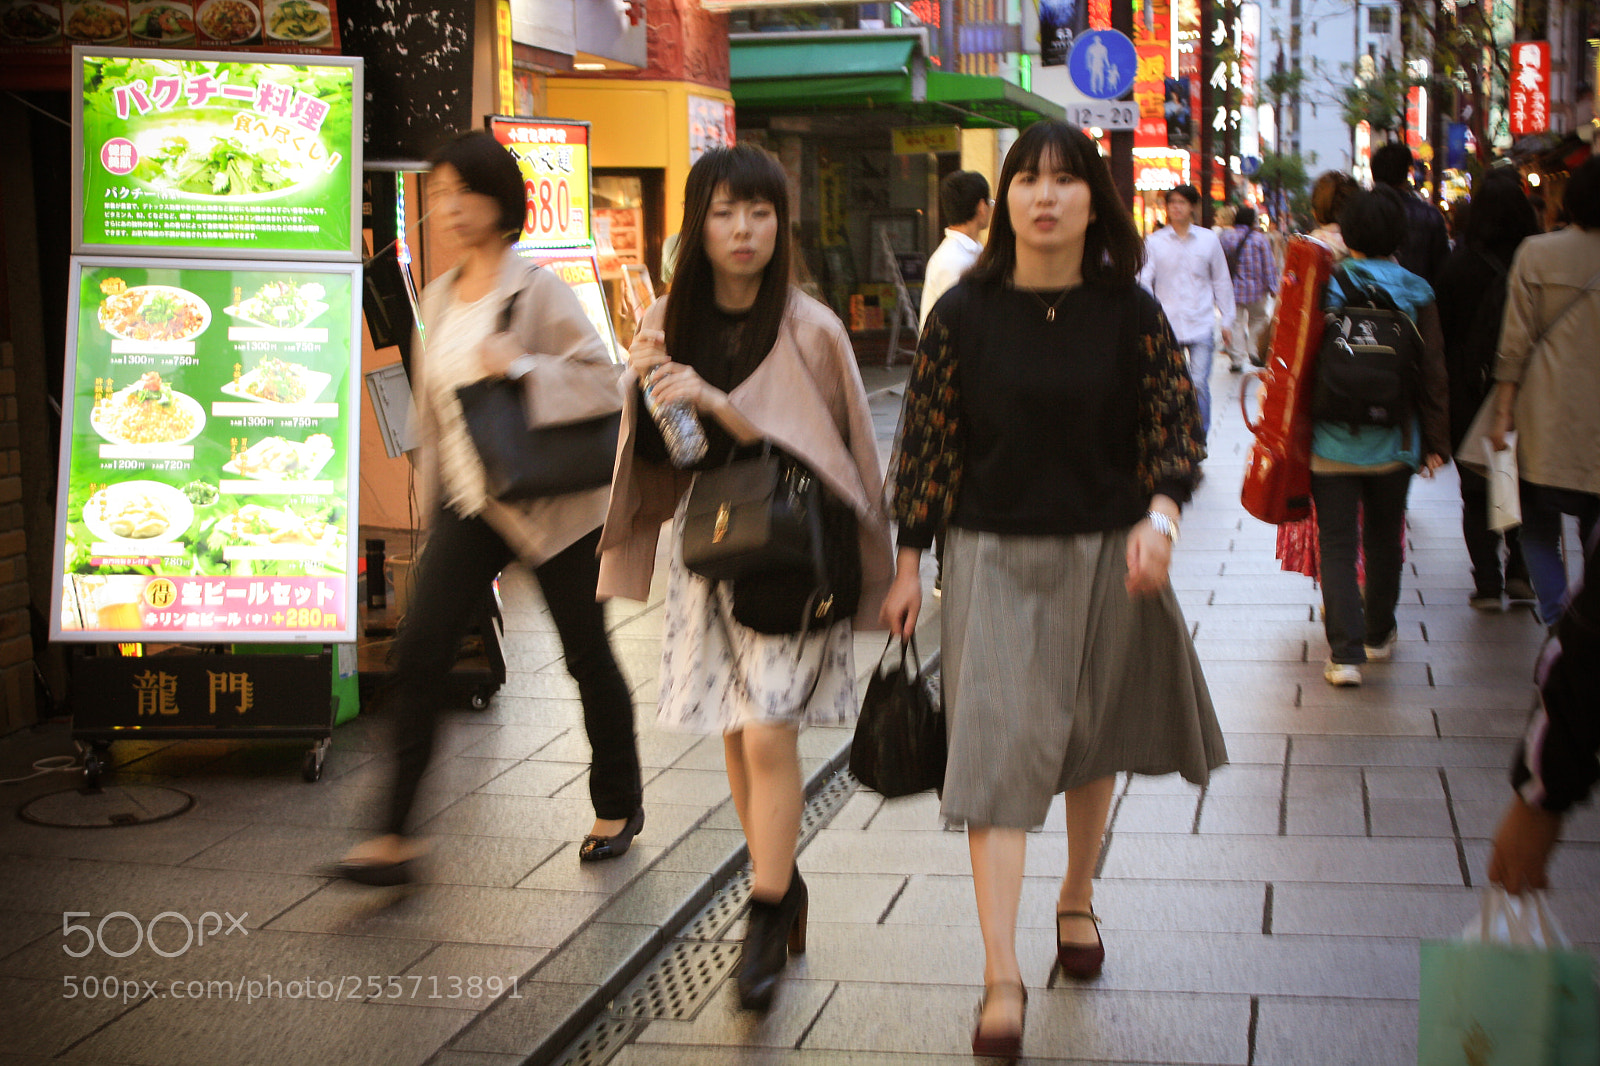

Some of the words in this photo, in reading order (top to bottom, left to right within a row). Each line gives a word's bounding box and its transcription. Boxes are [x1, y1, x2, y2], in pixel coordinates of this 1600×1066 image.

[113, 74, 329, 132] パクチー料理
[1075, 107, 1134, 126] 12-20
[151, 583, 172, 604] 得
[181, 580, 335, 606] 生ビールセット
[271, 608, 337, 627] +280円
[133, 669, 254, 715] 龍門
